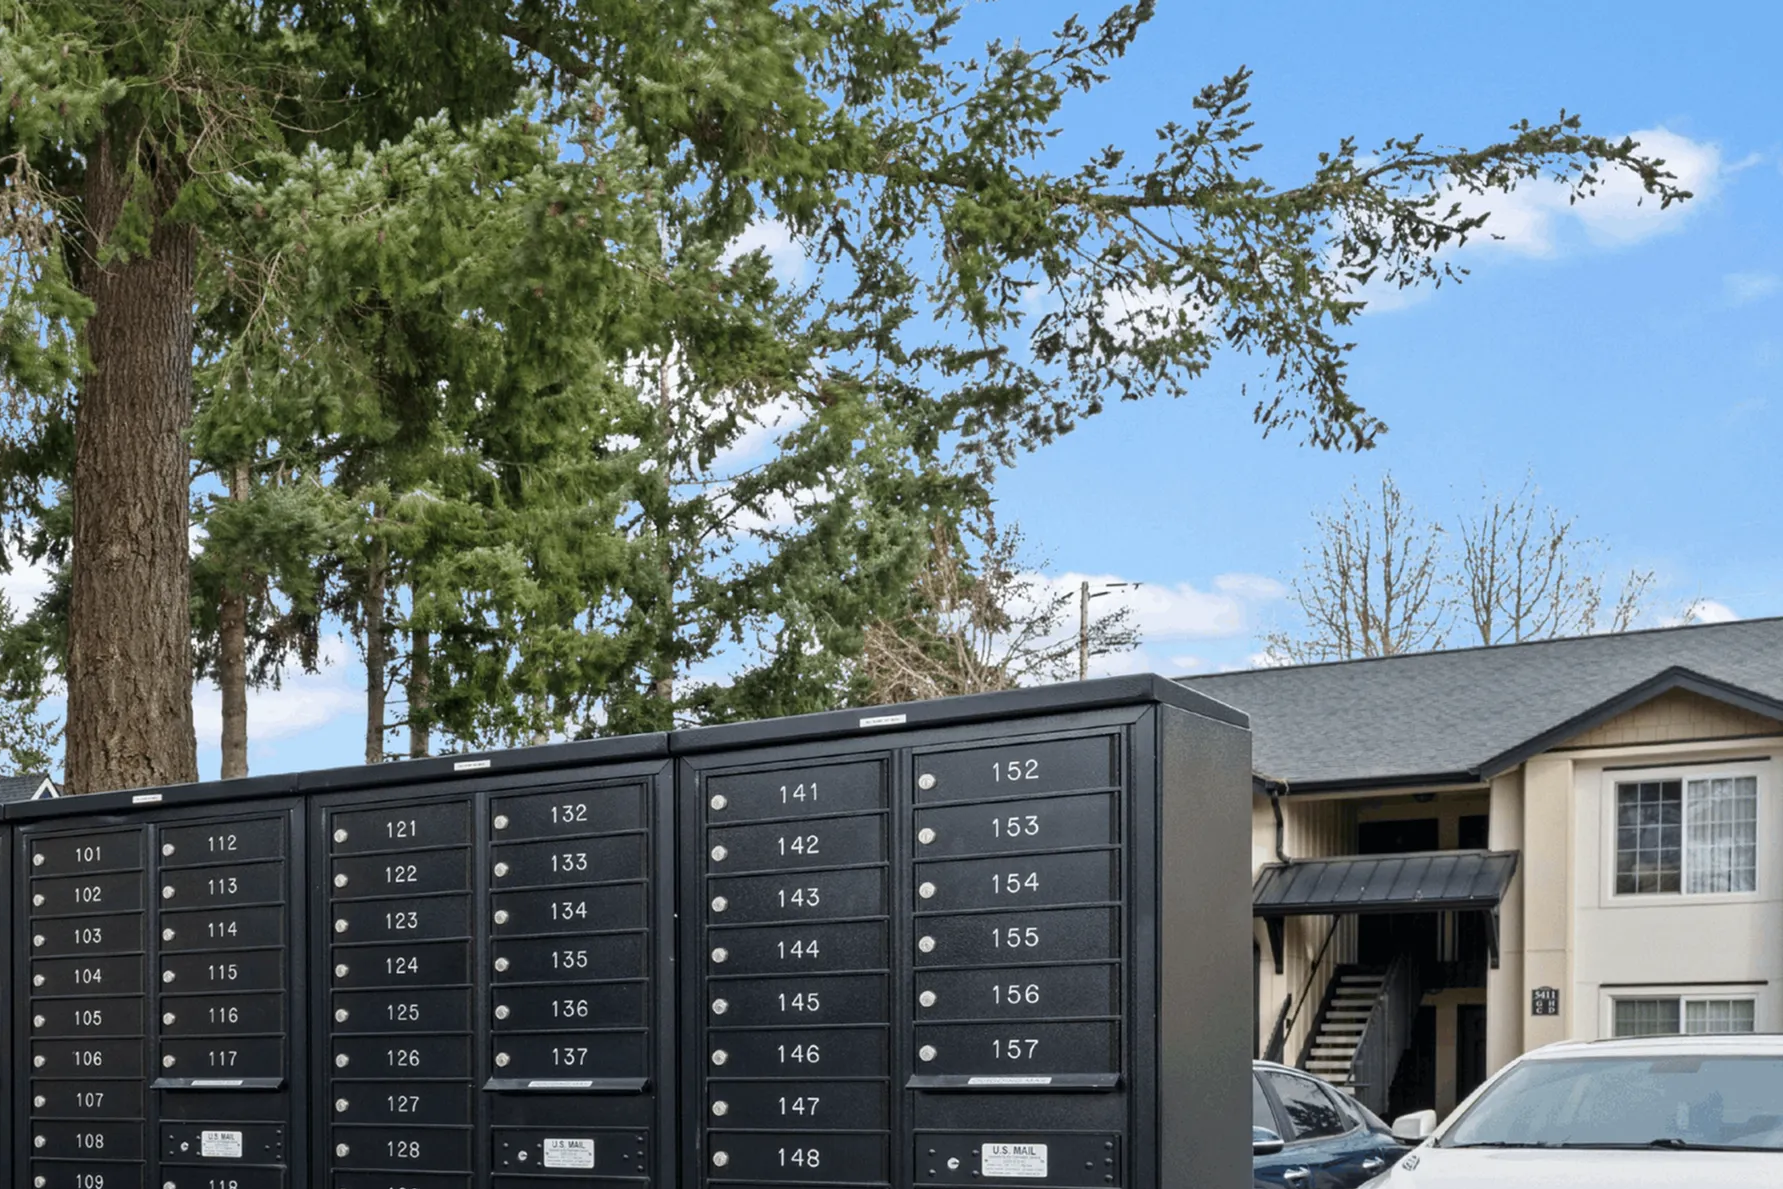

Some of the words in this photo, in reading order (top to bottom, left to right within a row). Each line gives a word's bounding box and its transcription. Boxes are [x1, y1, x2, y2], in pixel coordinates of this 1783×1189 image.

[992, 758, 1039, 782] 152
[780, 782, 817, 804] 141
[551, 803, 588, 824] 132
[386, 819, 416, 838] 121
[992, 815, 1040, 838] 153
[208, 834, 237, 852] 112
[778, 834, 820, 856] 142
[75, 846, 101, 862] 101
[551, 852, 588, 872] 133
[385, 864, 418, 883] 122
[992, 871, 1040, 894] 154
[75, 885, 102, 903] 102
[208, 877, 238, 895] 113
[778, 887, 820, 908] 143
[551, 901, 588, 920] 134
[208, 921, 238, 938] 114
[386, 911, 418, 930] 123
[74, 927, 102, 944] 103
[992, 927, 1039, 948] 155
[777, 939, 820, 959] 144
[386, 956, 419, 974] 124
[552, 950, 588, 969] 135
[74, 968, 102, 984] 104
[208, 963, 238, 981] 115
[778, 992, 820, 1012] 145
[992, 983, 1040, 1005] 156
[75, 1010, 102, 1026] 105
[209, 1006, 239, 1024] 116
[387, 1003, 420, 1021] 125
[552, 999, 588, 1018] 136
[75, 1050, 102, 1066] 106
[208, 1050, 238, 1067] 117
[387, 1049, 420, 1067] 126
[552, 1047, 588, 1066] 137
[778, 1044, 820, 1064] 146
[992, 1039, 1039, 1060] 157
[76, 1092, 104, 1108] 107
[387, 1095, 420, 1113] 127
[778, 1096, 820, 1116] 147
[76, 1133, 104, 1149] 108
[220, 1133, 236, 1141] MAIL
[568, 1141, 586, 1149] MAIL
[387, 1140, 420, 1159] 128
[778, 1147, 820, 1168] 148
[992, 1146, 1011, 1155] U.S.
[1013, 1146, 1036, 1156] MAIL
[76, 1173, 104, 1189] 109
